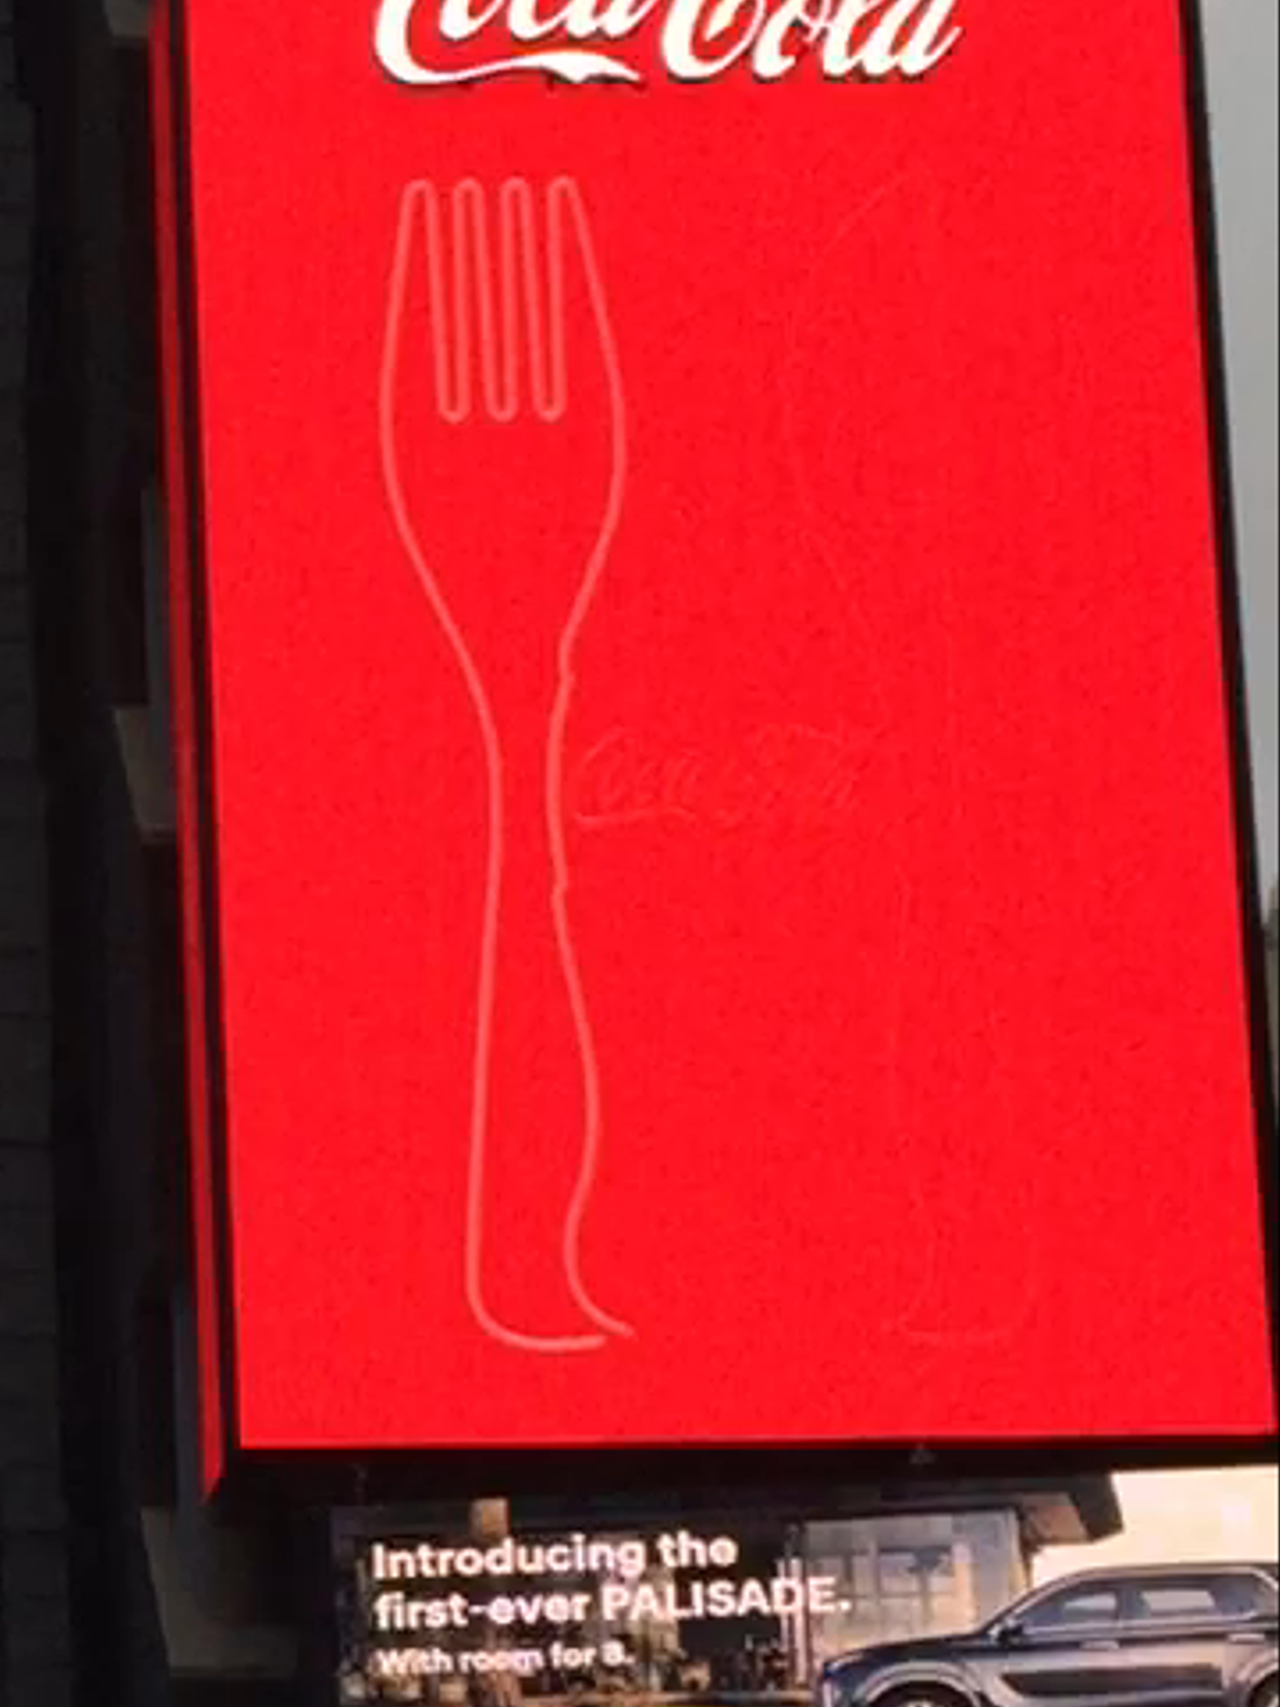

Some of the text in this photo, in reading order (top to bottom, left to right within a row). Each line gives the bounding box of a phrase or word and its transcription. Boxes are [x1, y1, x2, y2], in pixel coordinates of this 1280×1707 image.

[373, 1530, 738, 1579] Introducing the
[374, 1575, 852, 1630] first-ever PALISADE.
[376, 1647, 452, 1675] With
[459, 1647, 544, 1673] room
[549, 1643, 596, 1669] for
